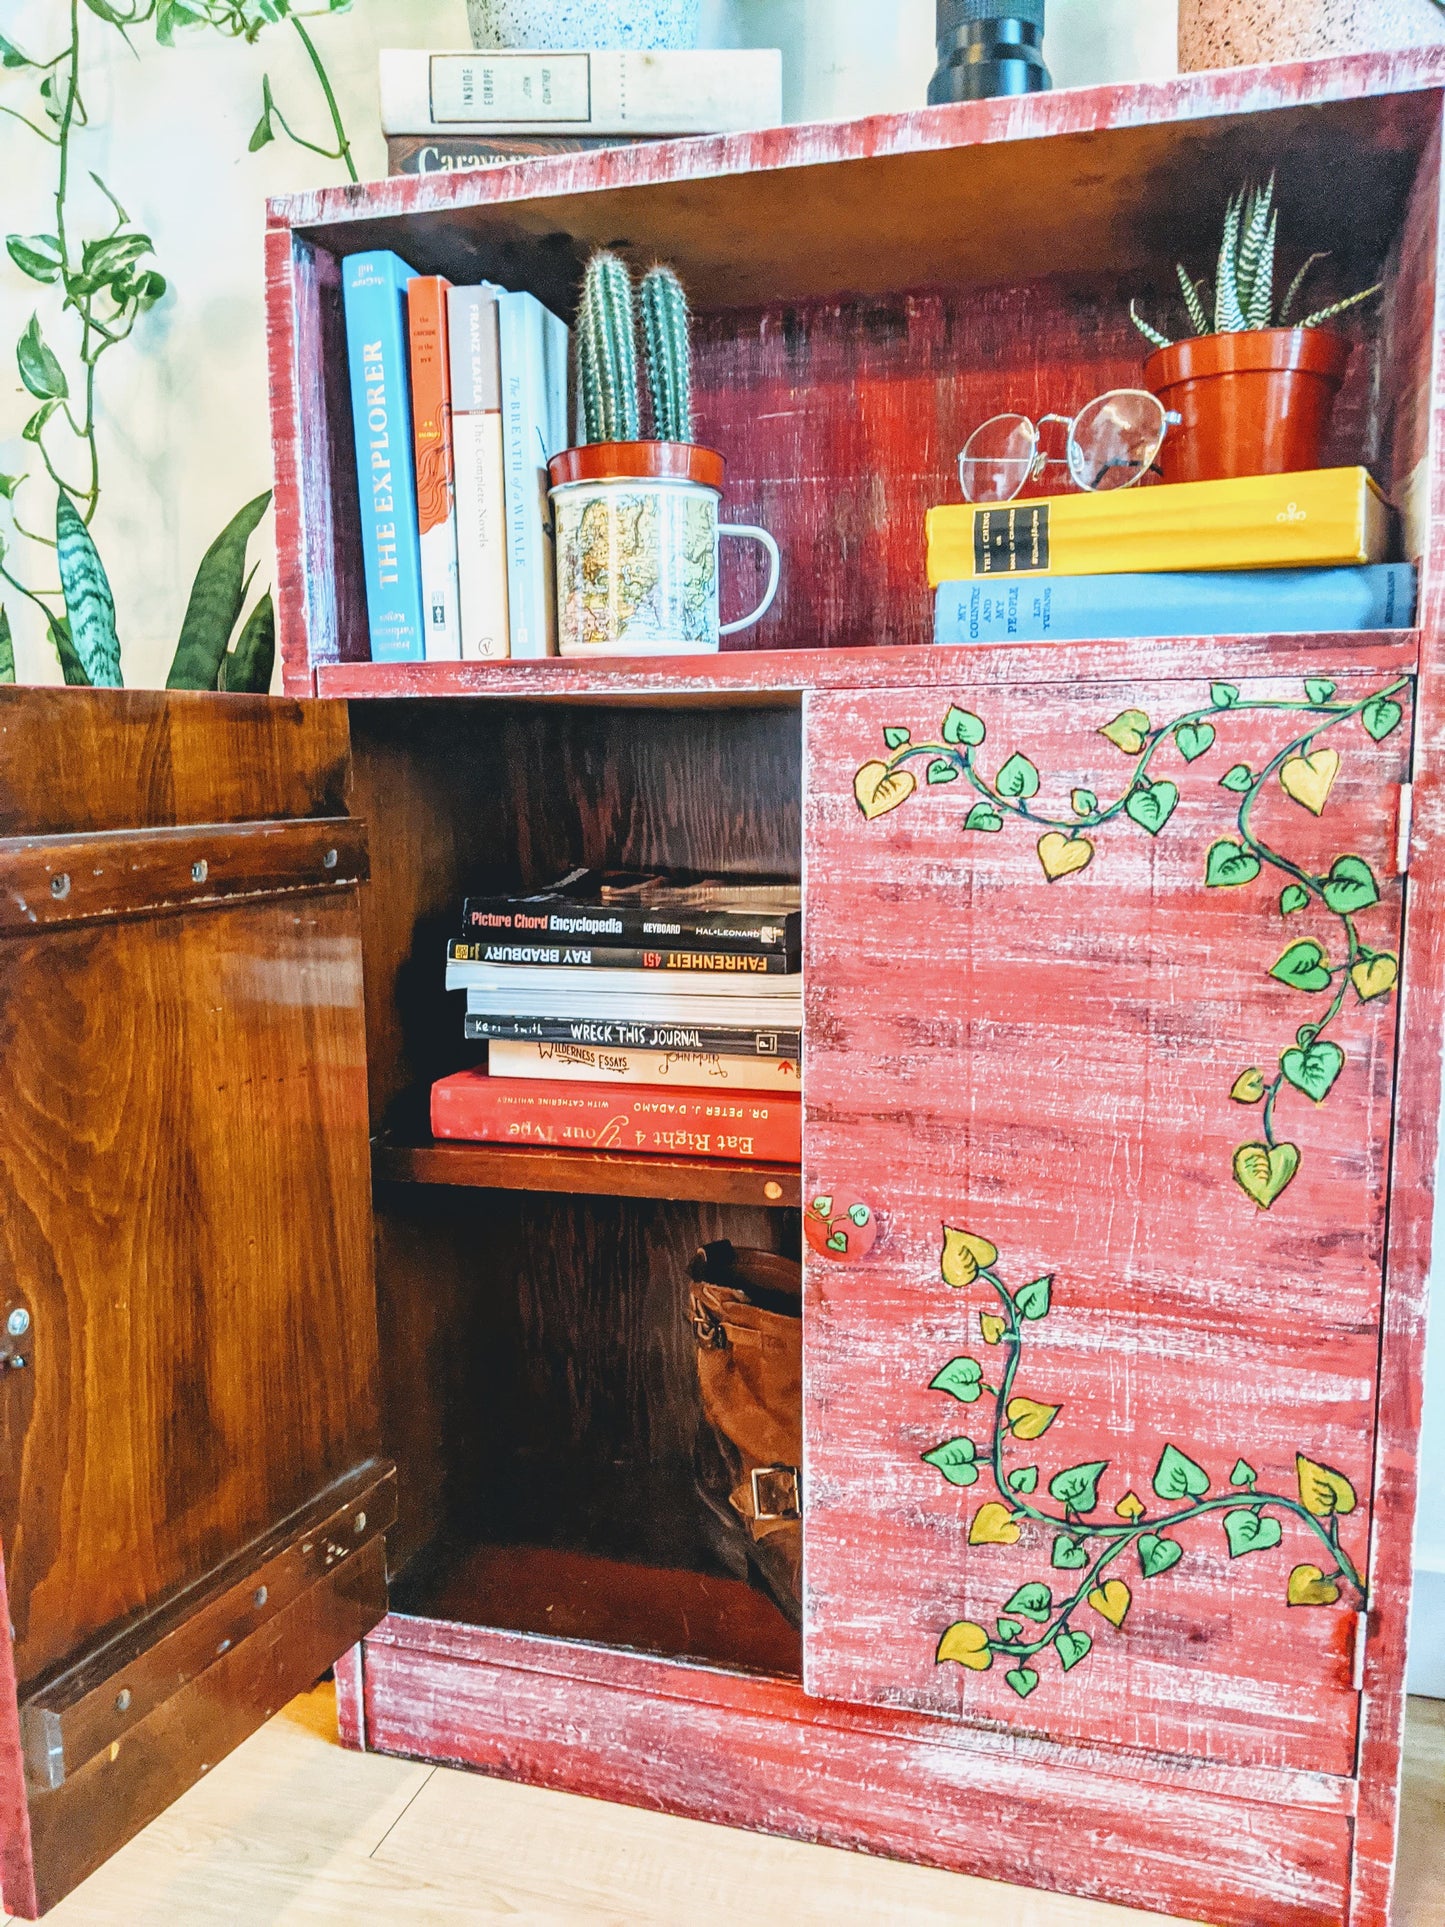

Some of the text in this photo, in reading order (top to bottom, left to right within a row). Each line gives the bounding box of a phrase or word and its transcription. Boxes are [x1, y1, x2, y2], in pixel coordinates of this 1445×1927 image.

[463, 69, 473, 105] INSIDE
[484, 69, 494, 105] EUROPE
[469, 303, 480, 354] FRANZ
[471, 356, 482, 405] KAFKA
[510, 376, 520, 398] The
[474, 423, 484, 444] The
[511, 402, 523, 471] BREATH
[363, 339, 398, 590] THE EXPLORER
[474, 449, 487, 504] Complete
[511, 477, 523, 492] of
[477, 508, 489, 549] Novels
[514, 504, 526, 567] WHALE
[957, 602, 966, 622] MY
[970, 586, 980, 639] COUNTRY
[983, 599, 992, 623] AND
[995, 600, 1004, 620] MY
[1007, 586, 1019, 634] PEOPLE
[1033, 597, 1041, 618] LIN
[1043, 587, 1052, 632] YUTANG
[471, 911, 623, 934] Picture Chord Encyclopedia
[643, 922, 681, 934] KEYBOARD
[484, 946, 560, 963] BRADBURY
[563, 949, 592, 963] RAY
[643, 952, 768, 971] FAHRENHEIT 451
[475, 1020, 543, 1035] Keri Smith
[570, 1023, 703, 1047] WRECK THIS JOURNAL
[598, 1054, 628, 1069] ESSAYS
[659, 1052, 728, 1078] JOHN MUIR
[538, 1098, 584, 1108] CATHERINE
[633, 1102, 769, 1119] DR. PETER J. D'ADAMO
[509, 1115, 754, 1155] Eat Right 4 Your Type
